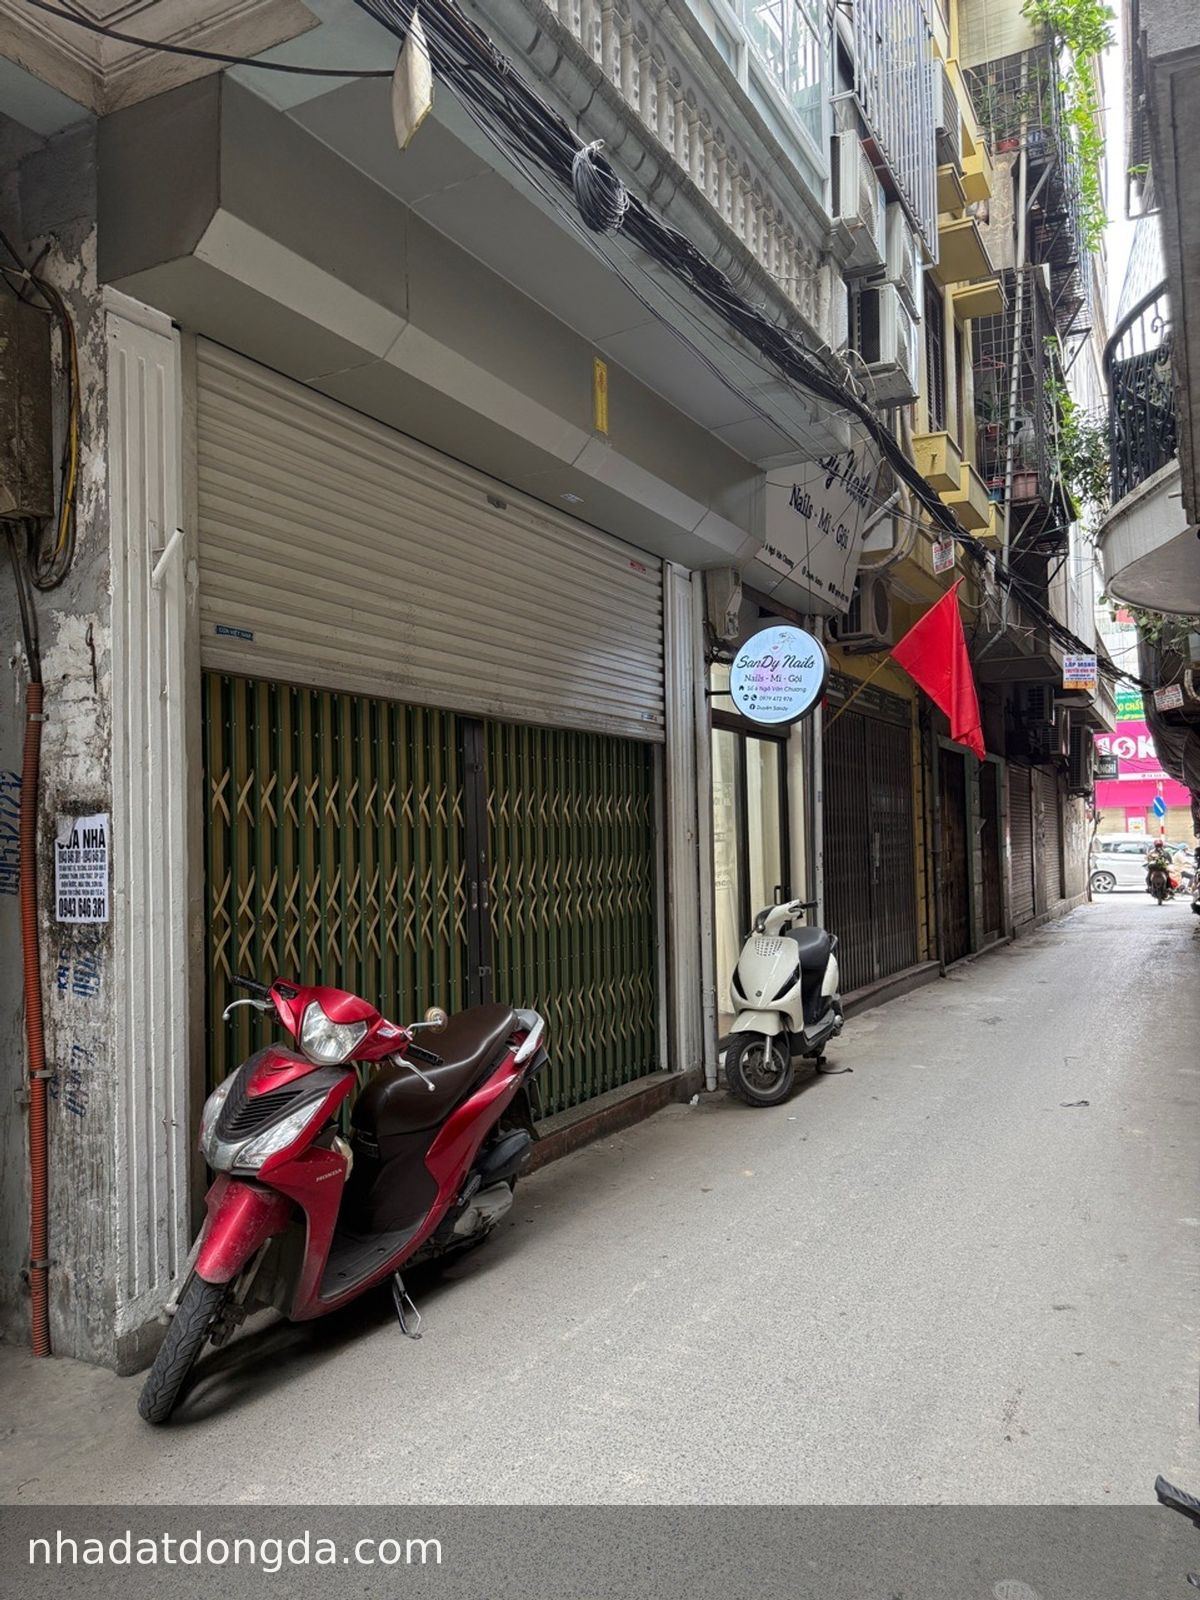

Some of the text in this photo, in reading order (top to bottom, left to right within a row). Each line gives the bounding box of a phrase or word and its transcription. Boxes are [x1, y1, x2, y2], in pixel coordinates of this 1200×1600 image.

[788, 483, 813, 520] Nails
[736, 654, 816, 672] SanDy Nails
[744, 674, 764, 683] Nails
[82, 823, 106, 849] NHÀ
[58, 897, 105, 918] 0943 646 381
